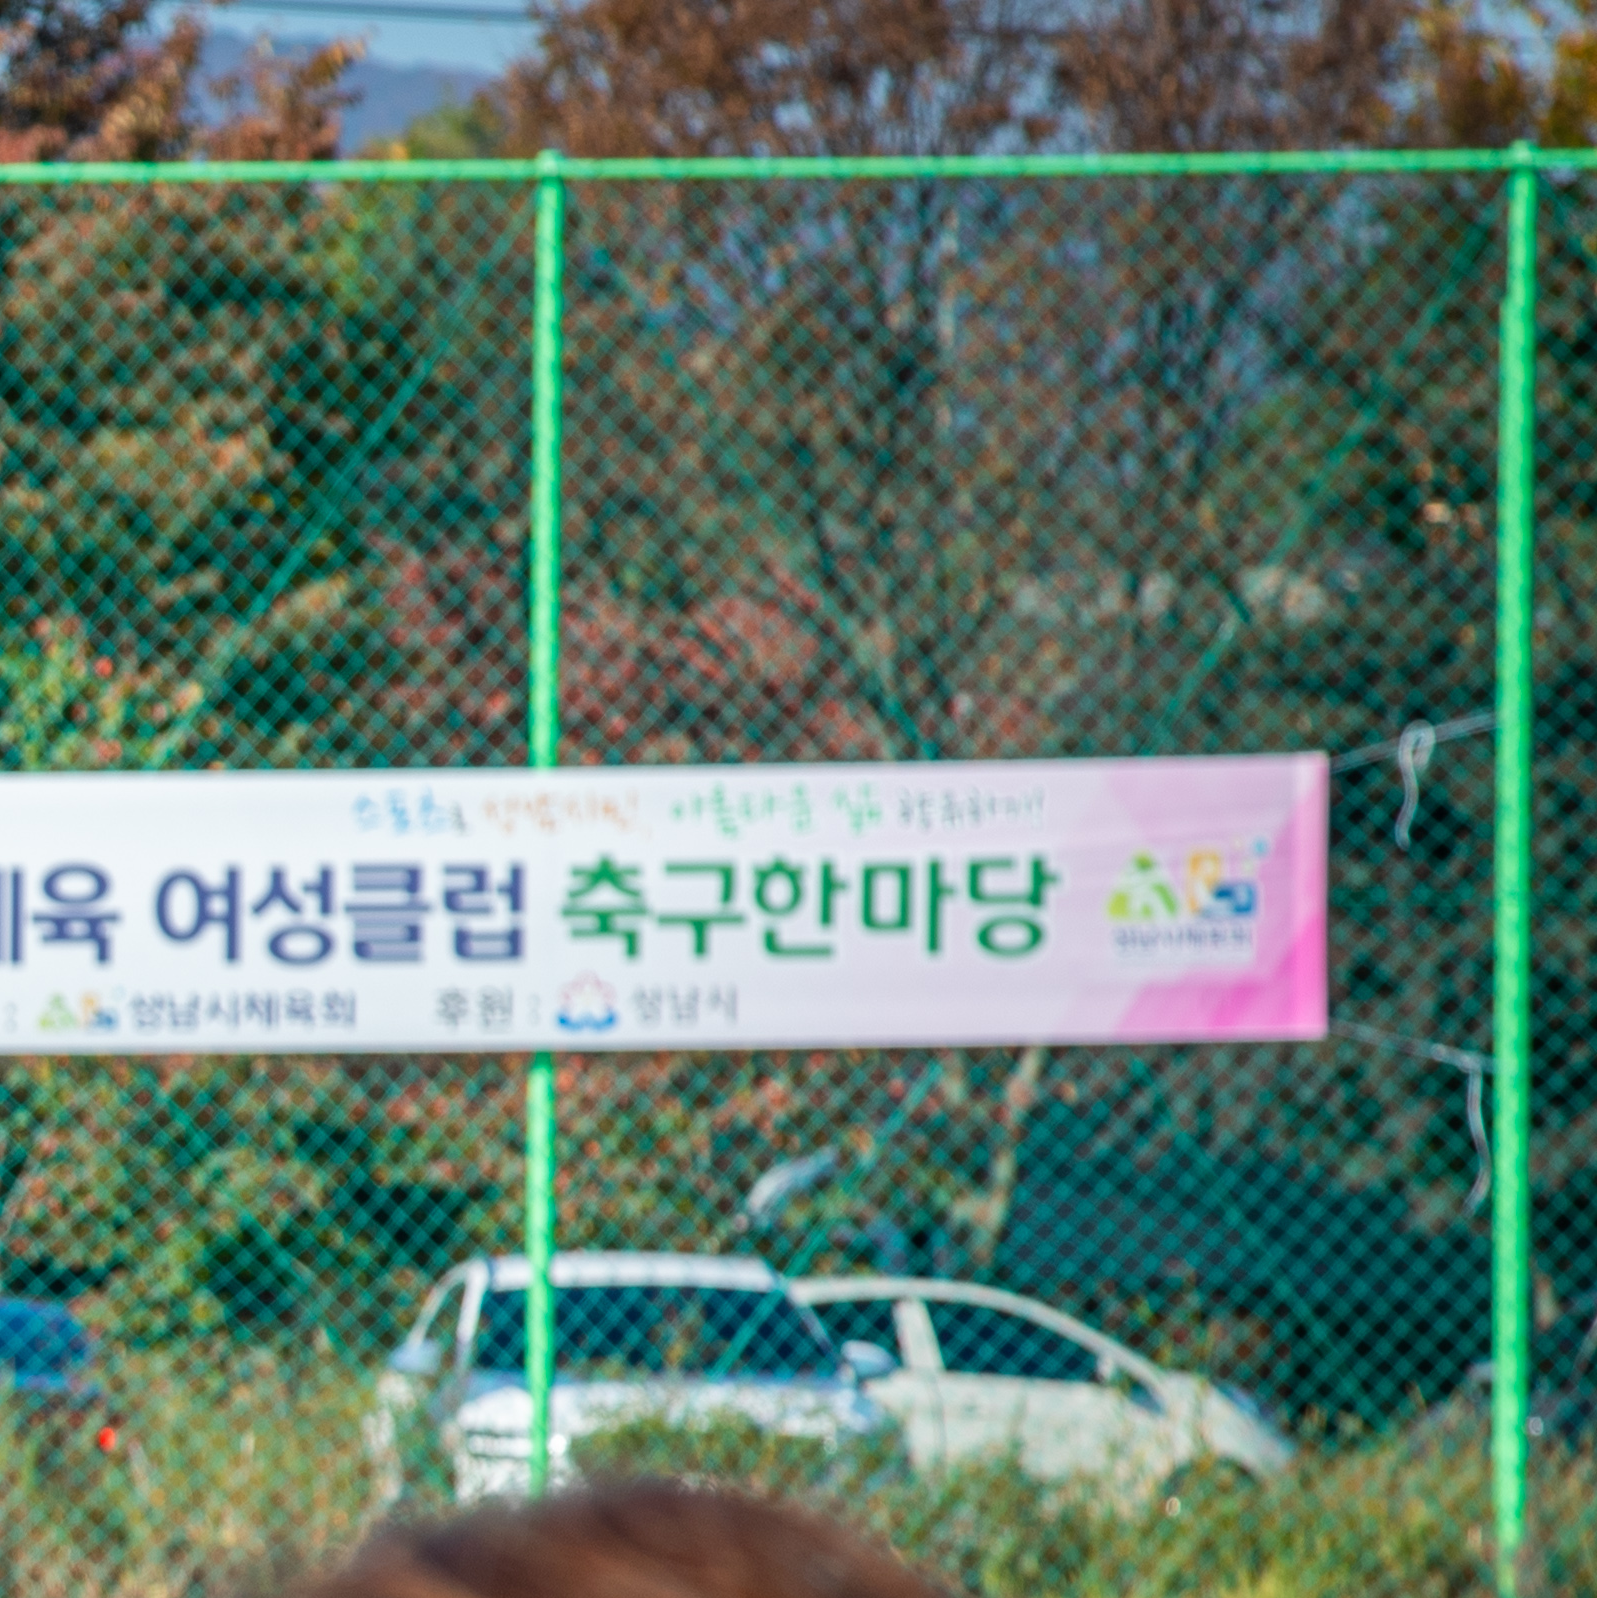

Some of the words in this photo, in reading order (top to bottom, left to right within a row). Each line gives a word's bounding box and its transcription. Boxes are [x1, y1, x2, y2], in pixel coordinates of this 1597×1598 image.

[154, 862, 525, 968] 여성클럽
[561, 855, 1059, 959] 축구한마당
[129, 990, 358, 1034] 성남시체육회
[630, 982, 740, 1028] 성남시
